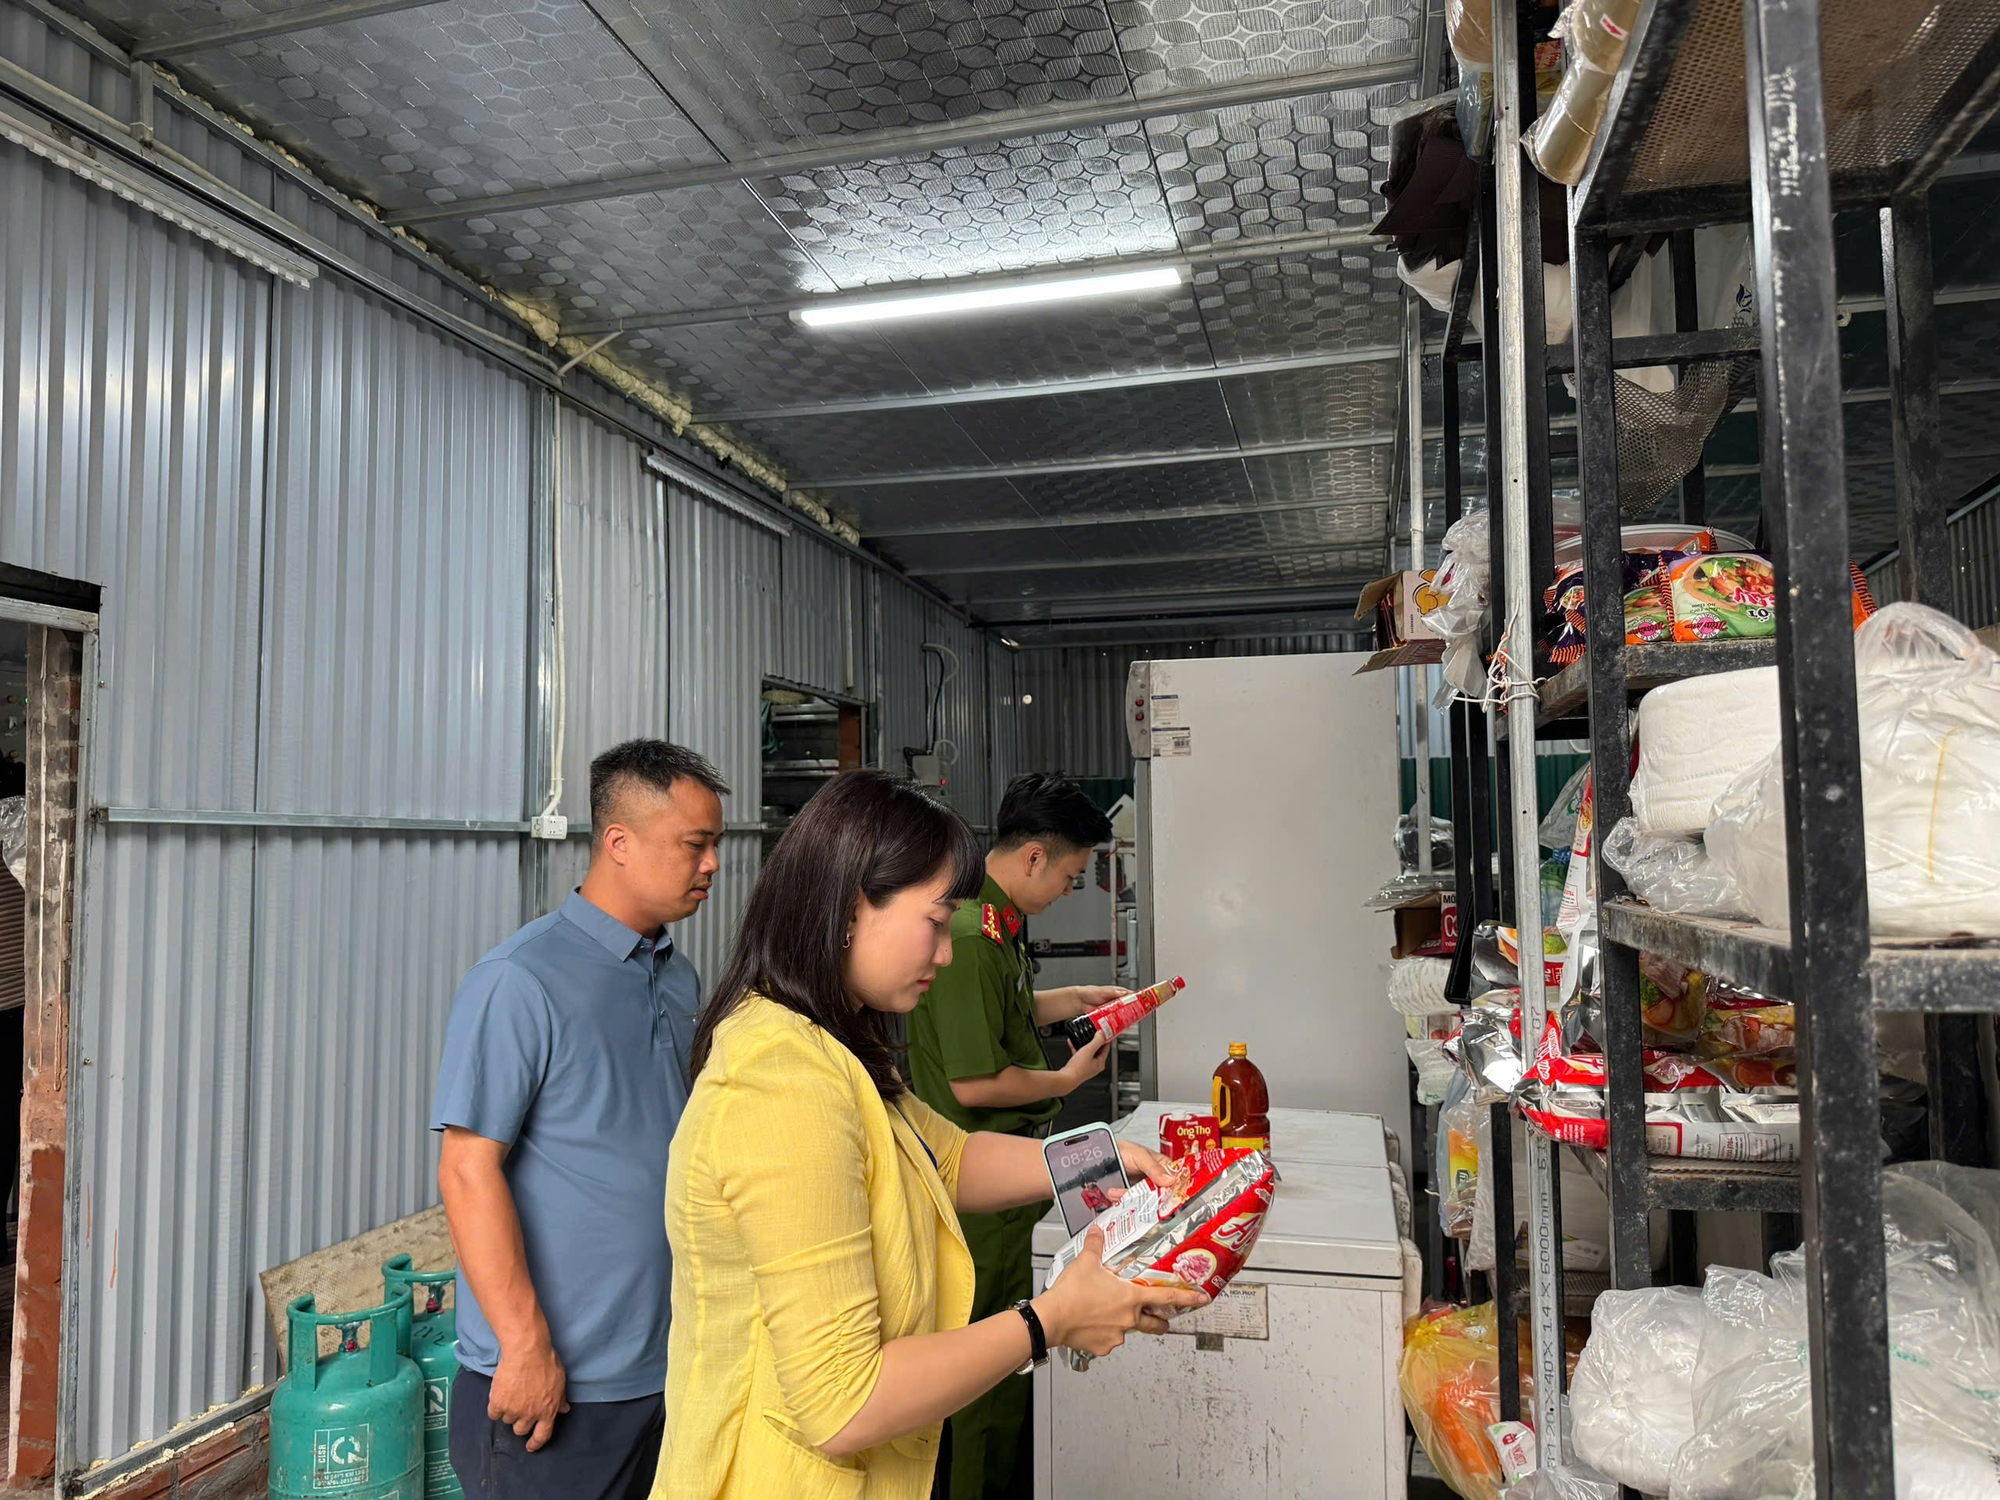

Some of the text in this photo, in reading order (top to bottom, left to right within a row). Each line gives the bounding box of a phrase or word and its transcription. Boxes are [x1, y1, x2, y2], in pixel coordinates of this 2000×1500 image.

[1177, 1125, 1211, 1139] Ông Thọ
[1061, 1146, 1103, 1168] 08:26
